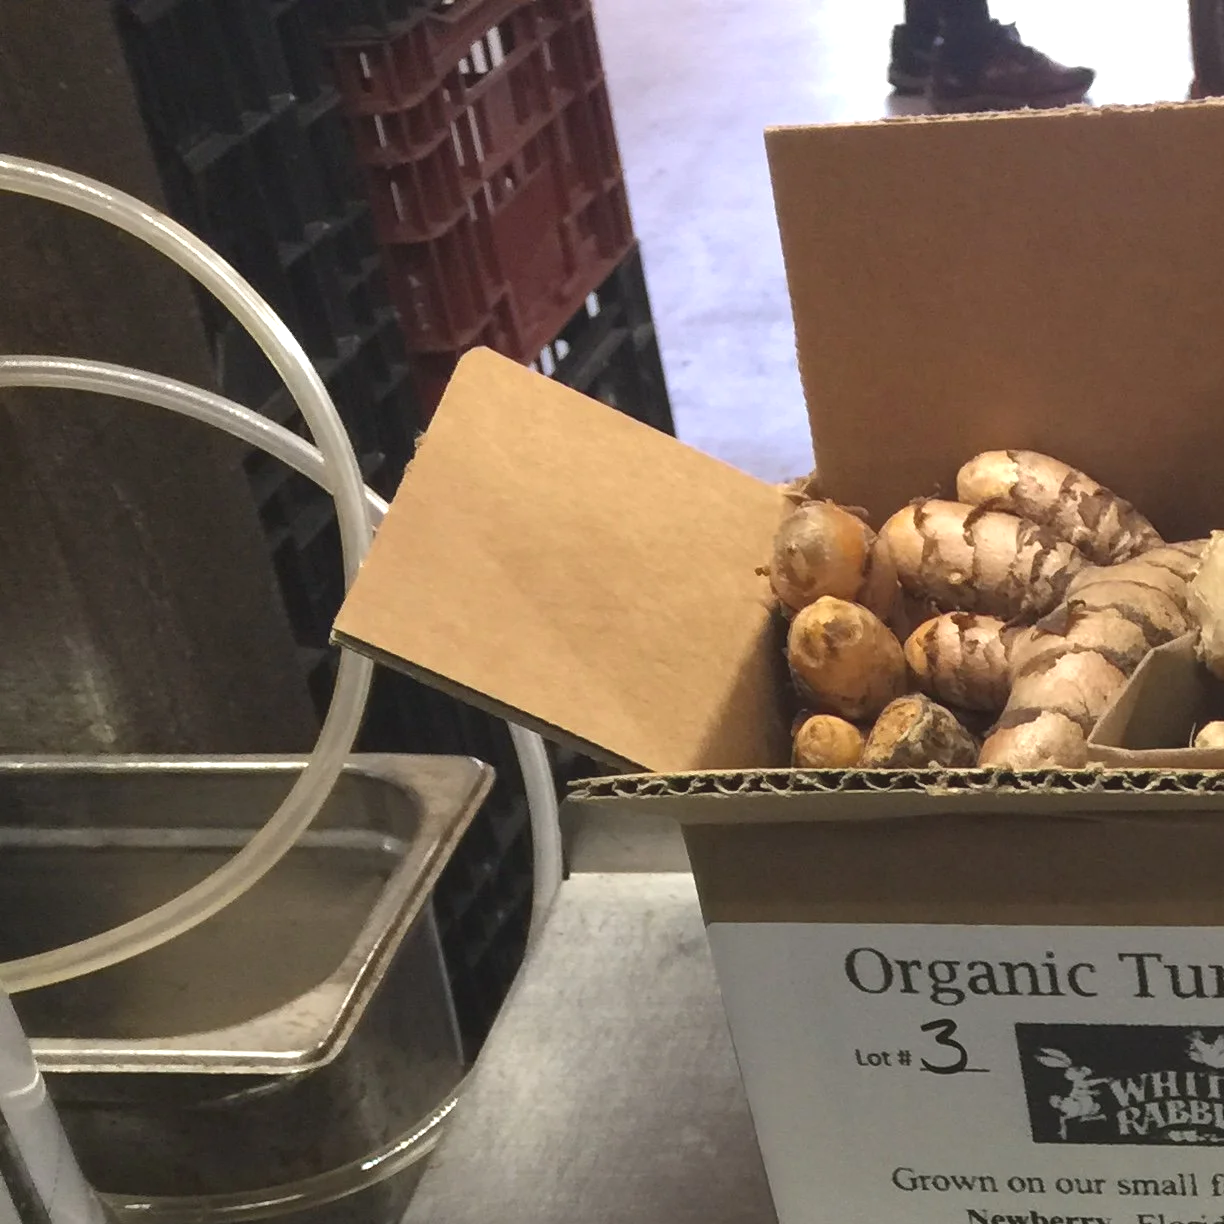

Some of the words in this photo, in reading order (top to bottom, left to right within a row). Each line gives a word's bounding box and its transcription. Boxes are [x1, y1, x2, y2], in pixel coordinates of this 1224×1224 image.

[845, 947, 1098, 1006] Organic
[855, 1049, 889, 1067] Lot
[898, 1049, 912, 1067] #
[920, 1018, 968, 1075] 3
[892, 1166, 999, 1193] Grown
[1007, 1174, 1045, 1194] on
[1066, 1174, 1106, 1195] our
[1117, 1171, 1199, 1198] small
